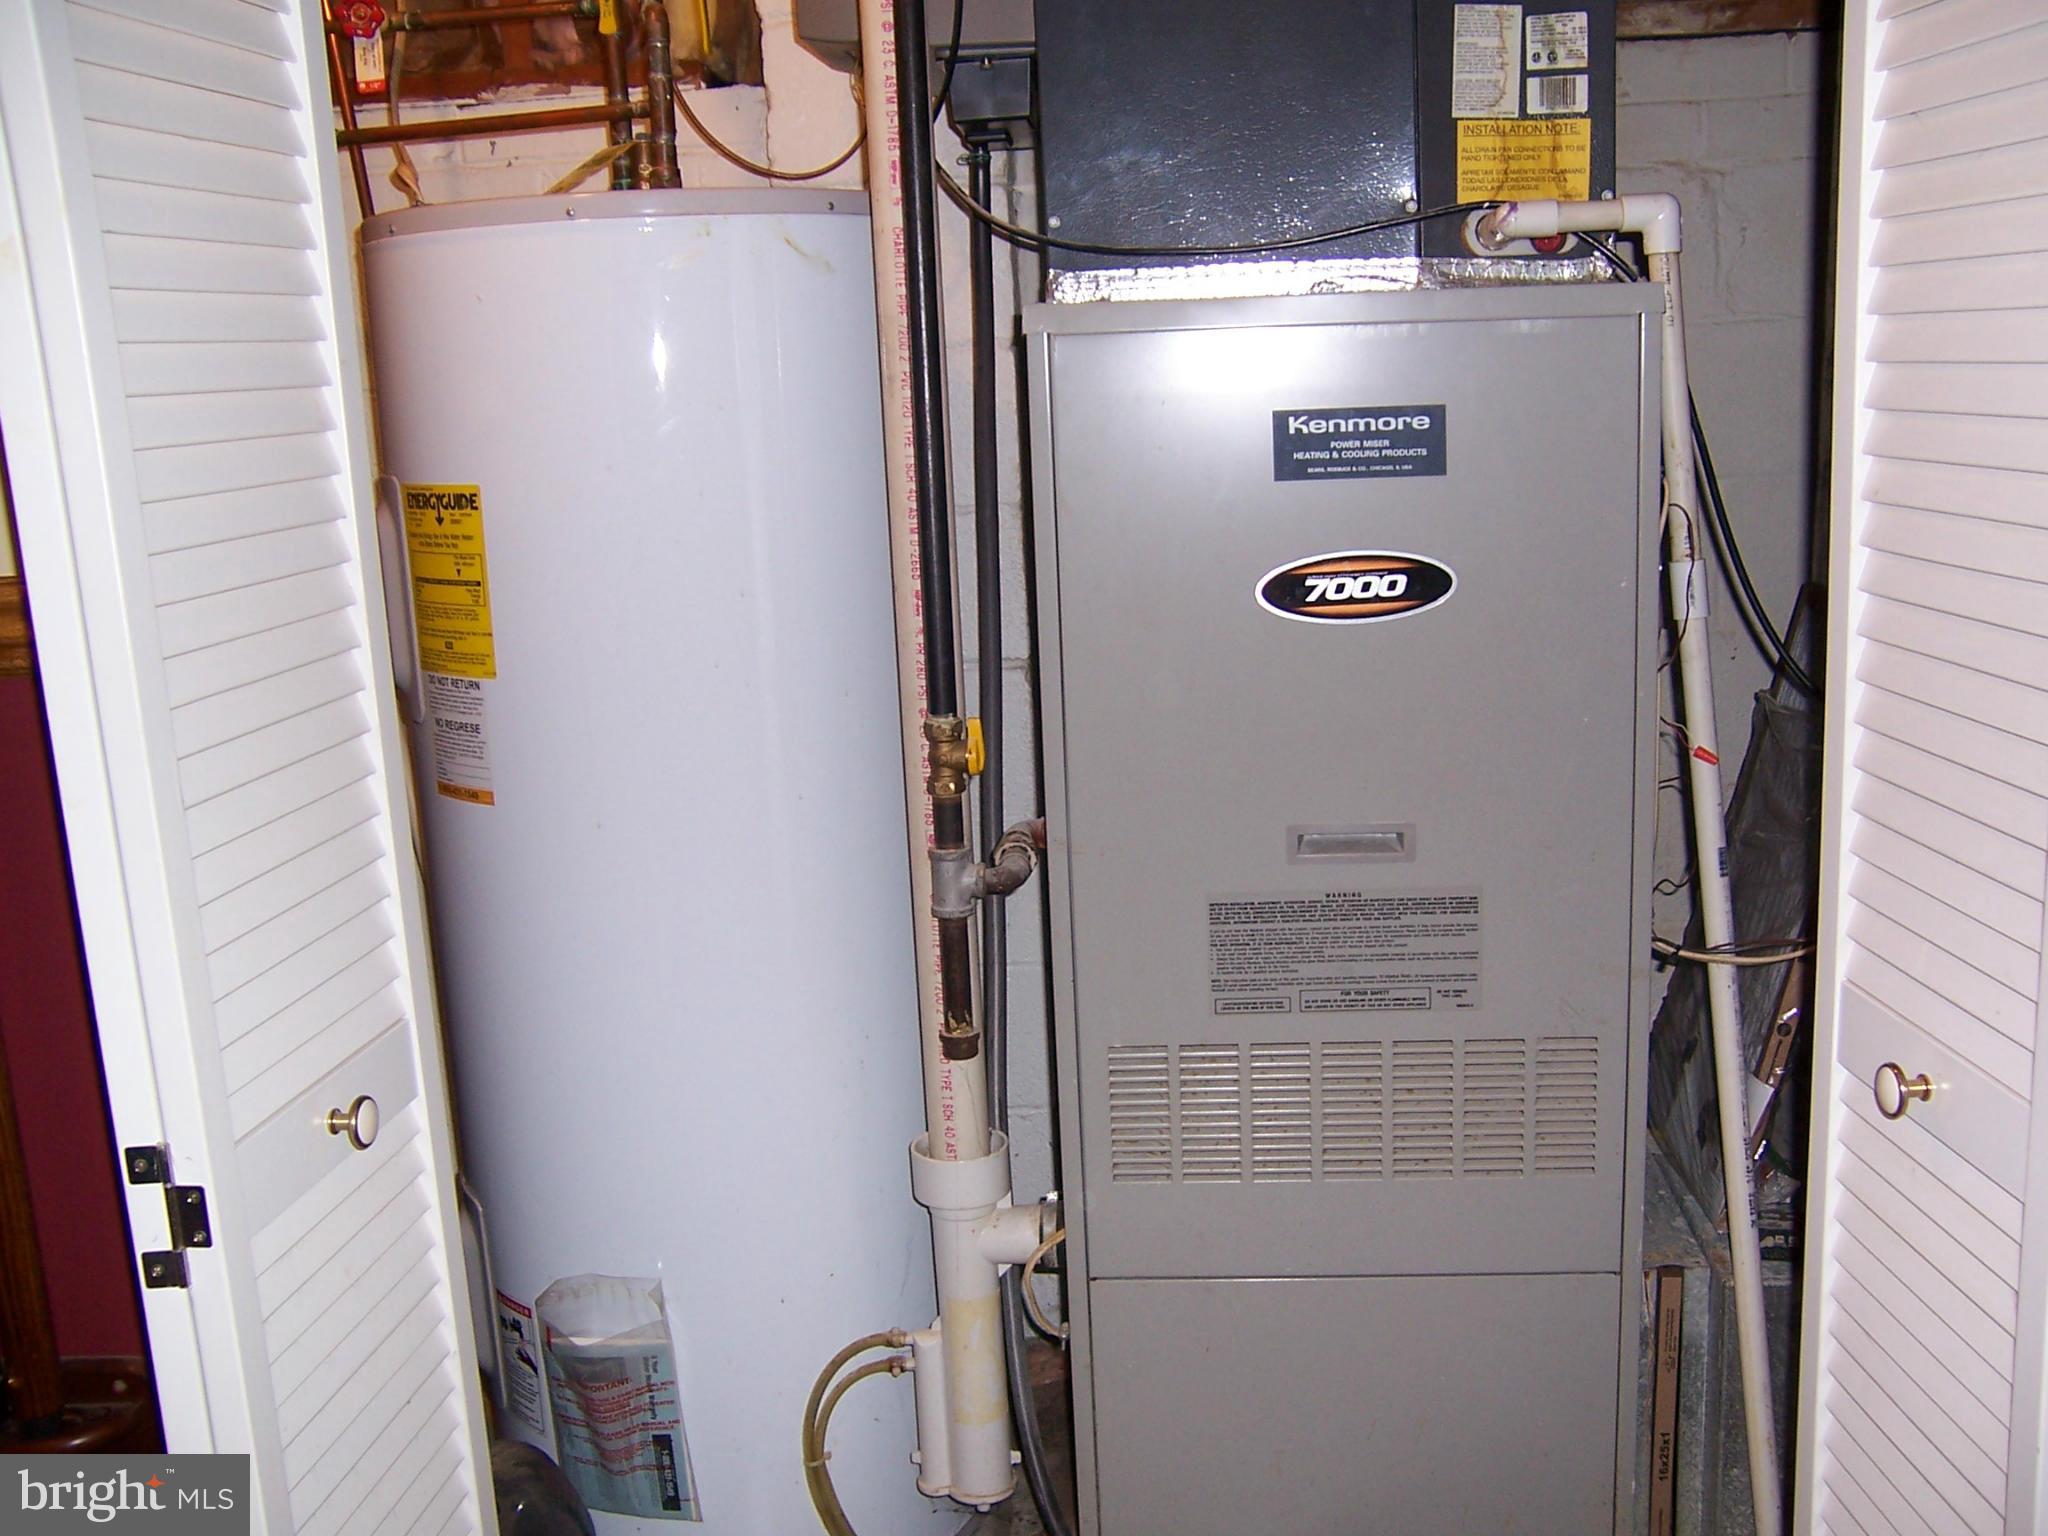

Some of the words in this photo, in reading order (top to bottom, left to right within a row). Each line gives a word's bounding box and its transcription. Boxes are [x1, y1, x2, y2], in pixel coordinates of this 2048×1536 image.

[884, 75, 897, 104] ASTM
[1463, 124, 1543, 135] INSTALLATION
[900, 371, 912, 390] PVC
[1288, 415, 1431, 435] Kenmore
[1330, 440, 1360, 449] POWER
[1363, 439, 1390, 448] MISER
[1293, 451, 1330, 460] HEATING
[1332, 450, 1339, 459] &
[1341, 449, 1380, 459] COOLING
[1382, 448, 1428, 458] PRODUCTS
[406, 492, 479, 511] ENERGYGUIDE
[908, 507, 920, 534] ASTM
[1304, 574, 1408, 602] 7000
[437, 675, 449, 687] NOT
[451, 678, 481, 690] RETURN
[445, 719, 481, 735] REGRESE
[940, 1069, 952, 1091] TYPE
[942, 1103, 955, 1121] SCH
[944, 1126, 956, 1138] 40
[945, 1142, 957, 1160] AST
[1658, 1431, 1671, 1482] 16x25x1
